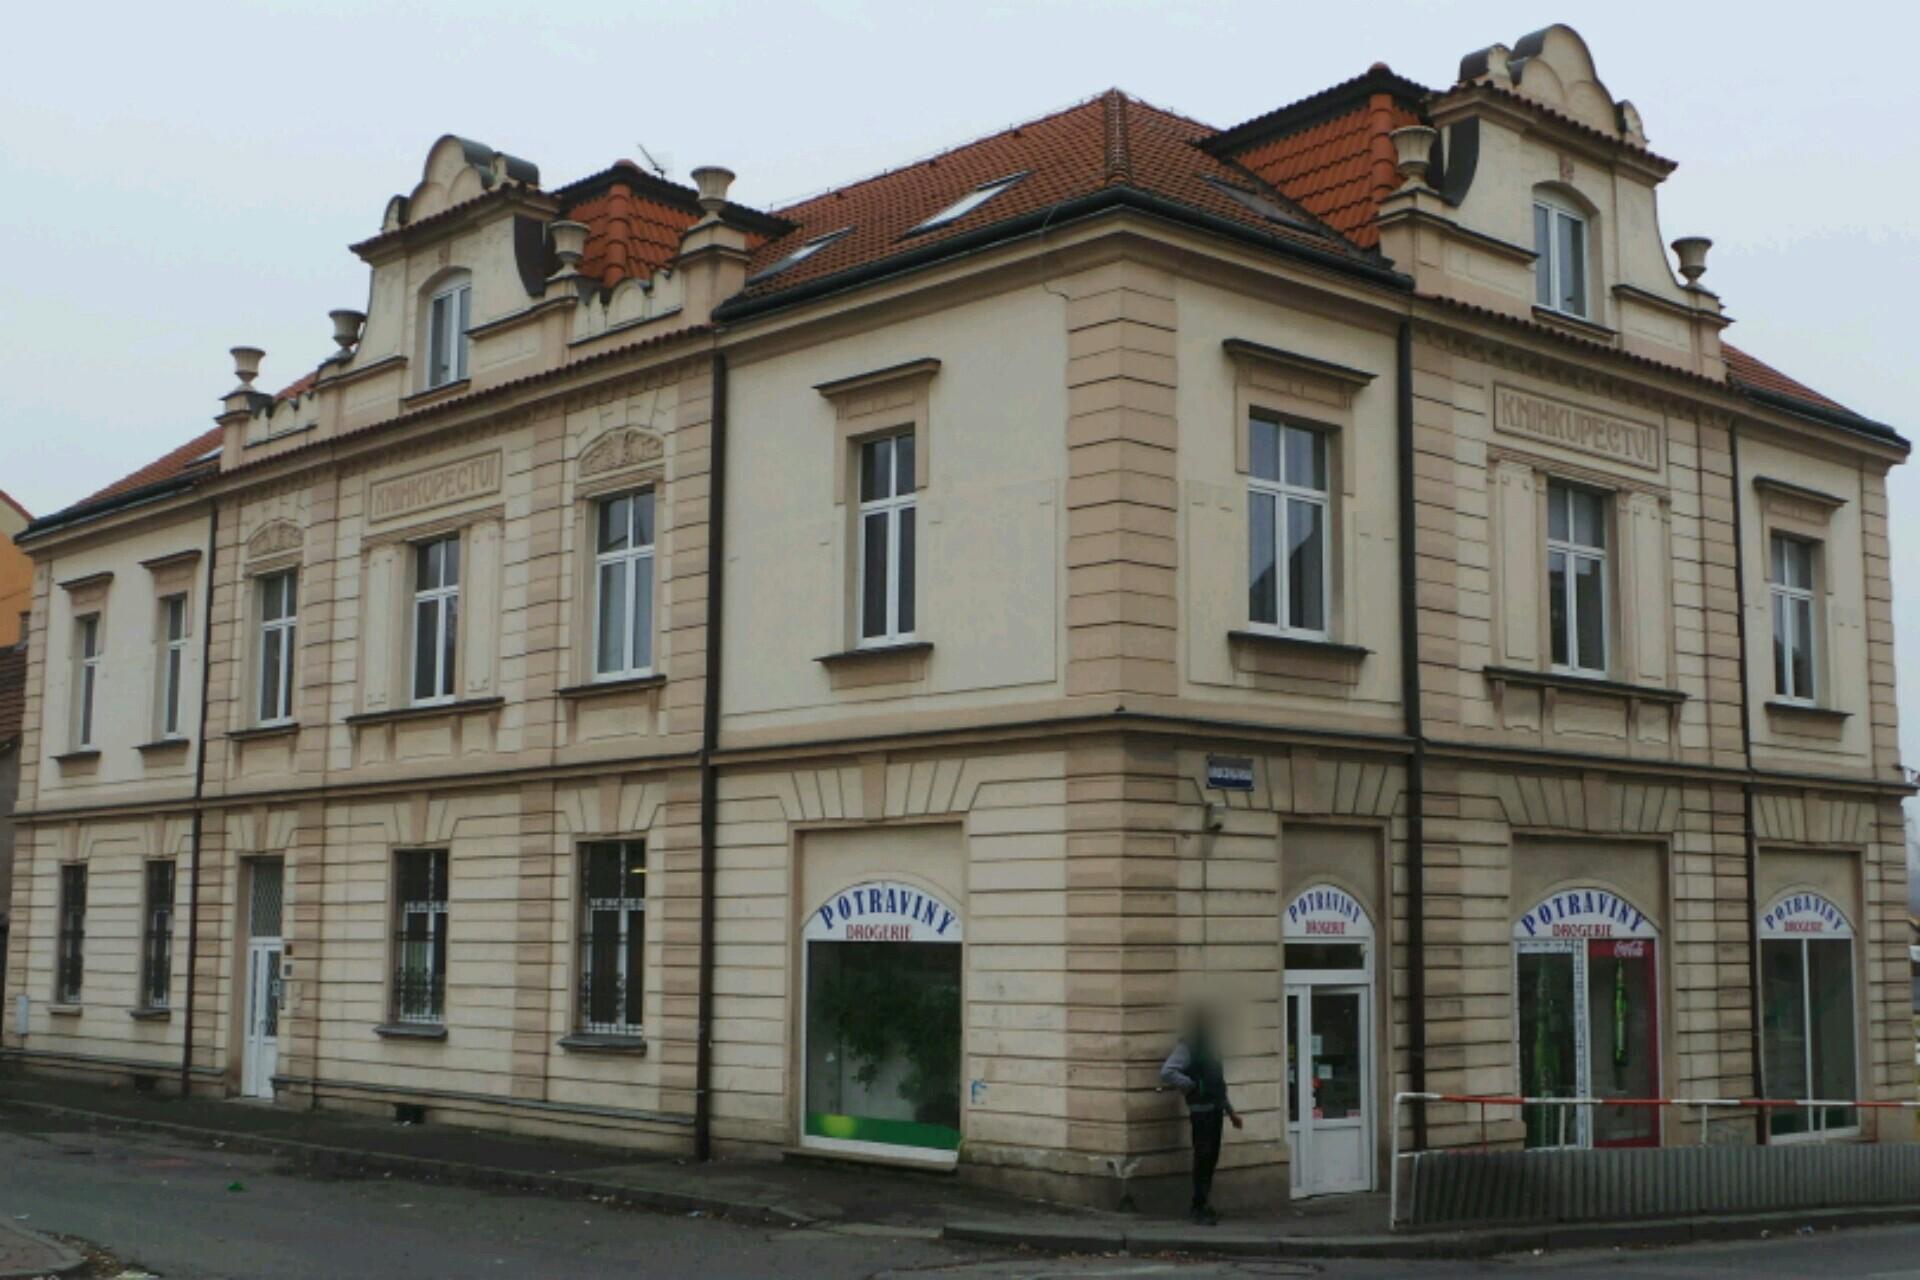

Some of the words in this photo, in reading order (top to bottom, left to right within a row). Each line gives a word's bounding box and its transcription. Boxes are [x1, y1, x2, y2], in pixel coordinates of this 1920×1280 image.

[820, 888, 956, 935] POTRAVINY
[1289, 891, 1361, 924] POTRAVINY
[1521, 891, 1644, 936] POTRAVINY
[1765, 896, 1843, 930] POTRAVINY
[846, 924, 912, 940] DROGERIE
[1552, 923, 1613, 937] DROGERIE
